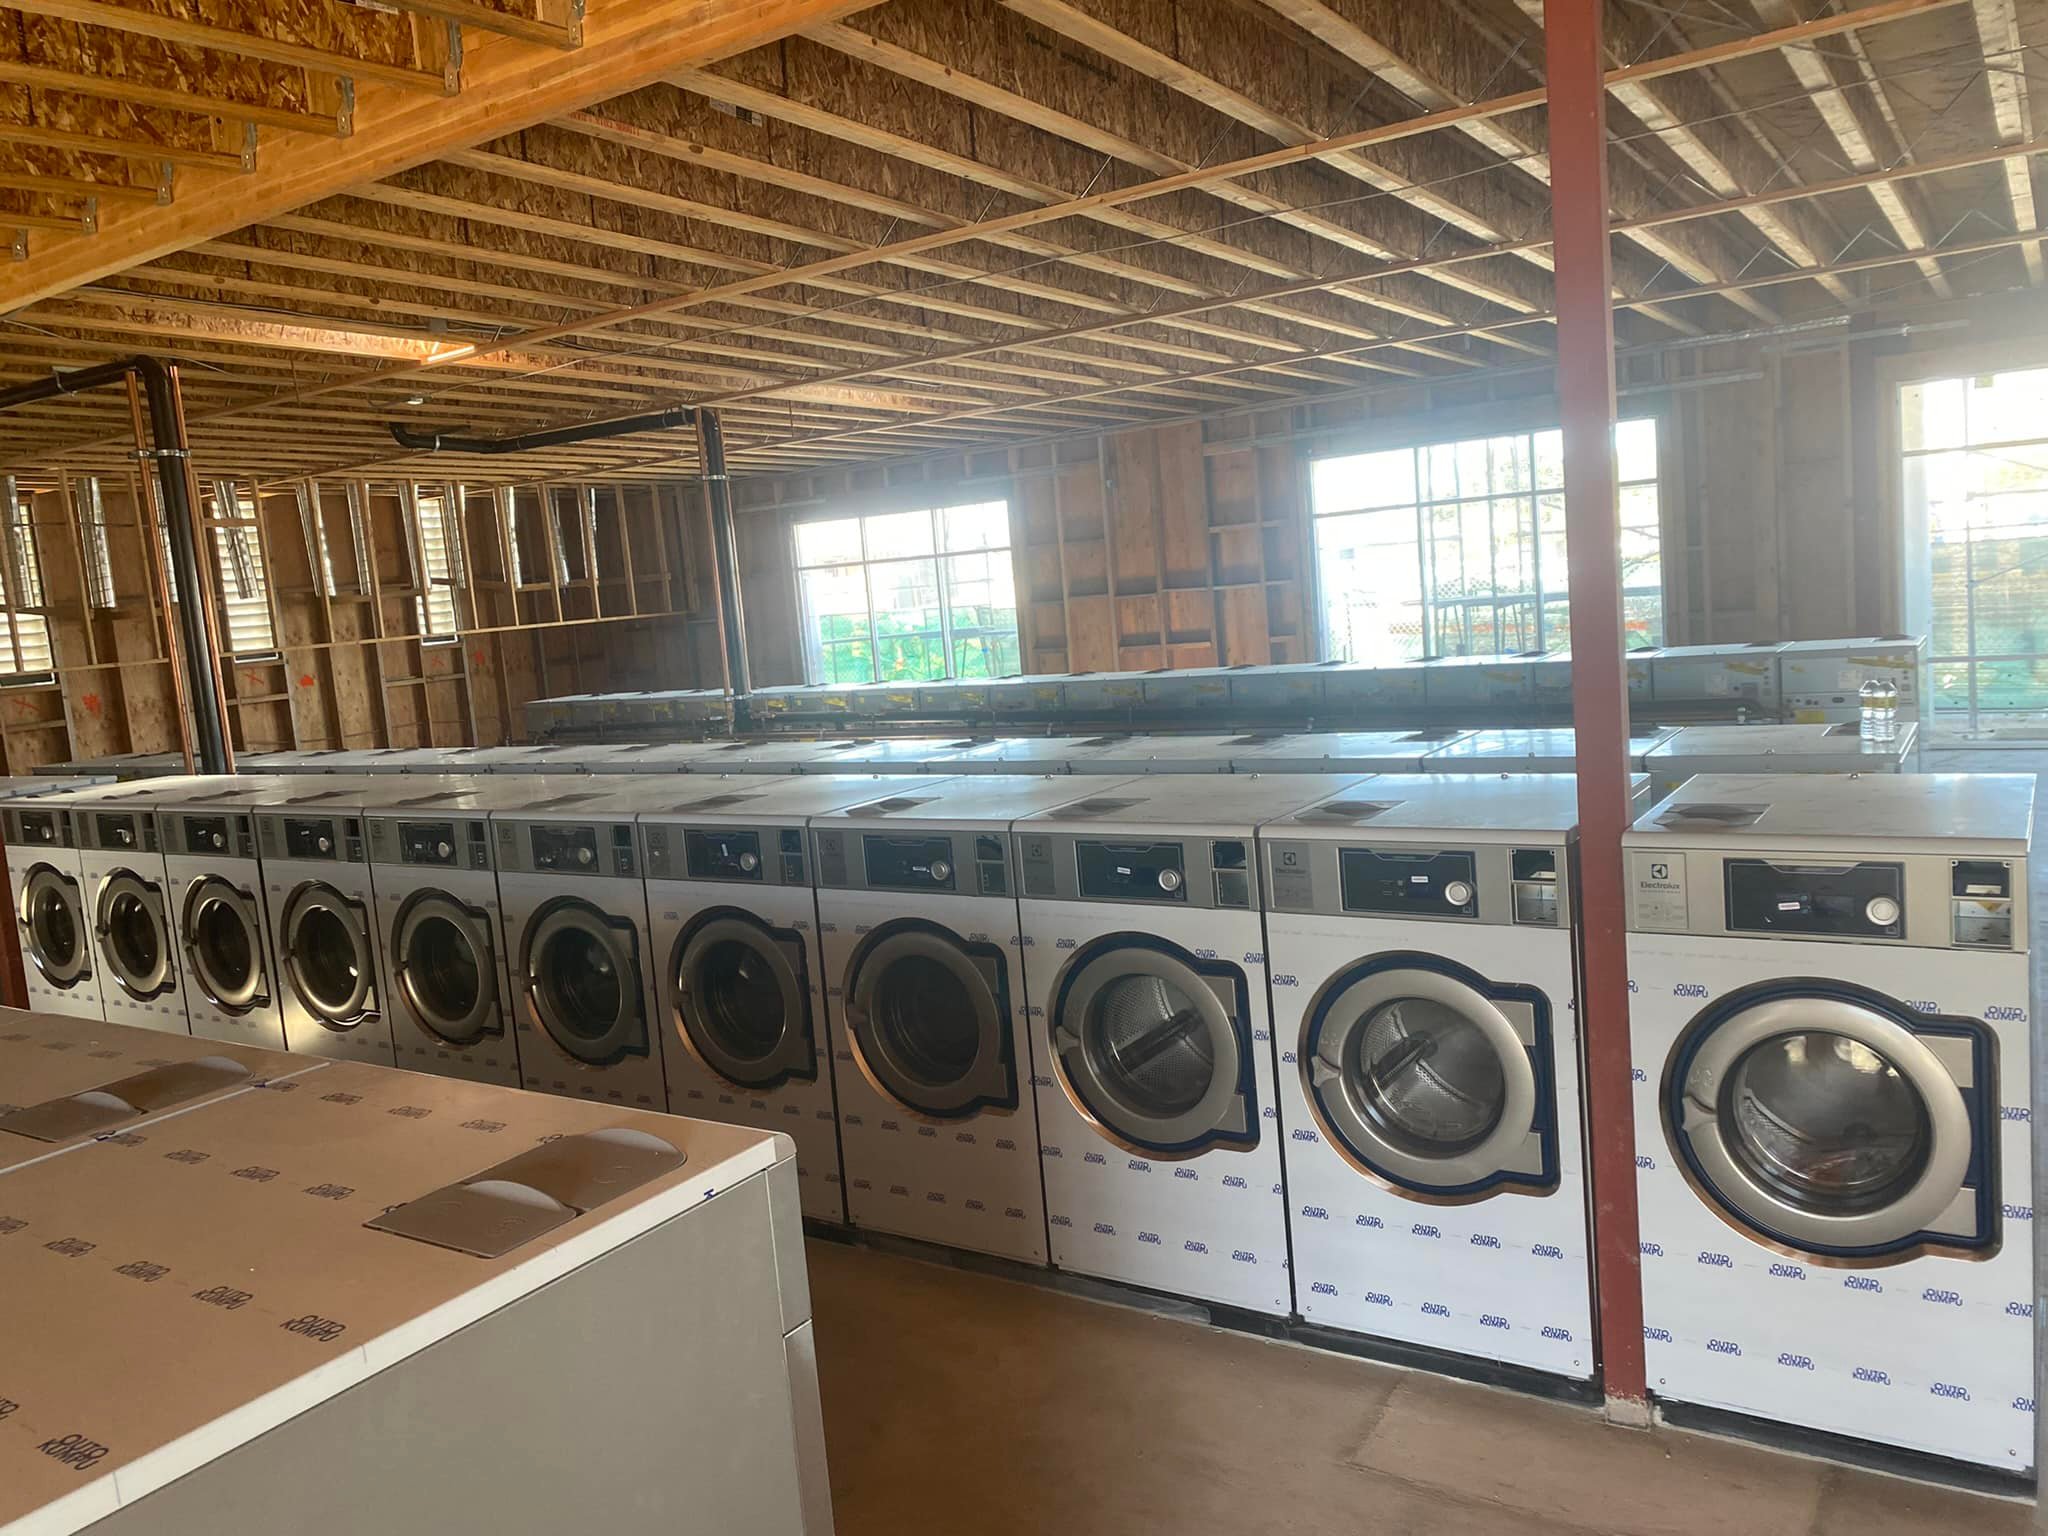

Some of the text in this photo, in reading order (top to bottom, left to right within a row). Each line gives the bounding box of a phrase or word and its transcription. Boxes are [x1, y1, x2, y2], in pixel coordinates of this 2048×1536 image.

[1701, 1251, 1728, 1261] OUTO
[1772, 1263, 1801, 1273] OUTO
[1847, 1275, 1879, 1285] OUTO
[1926, 1288, 1959, 1298] OUTO
[2005, 1306, 2032, 1317] KUM
[2009, 1302, 2032, 1310] OUT
[300, 1314, 346, 1333] OUTO
[1644, 1331, 1671, 1342] UMPU
[1709, 1339, 1738, 1349] OUTO
[1781, 1352, 1810, 1363] OUTO
[1856, 1367, 1887, 1378] OUTO
[1934, 1382, 1966, 1393] OUTO
[61, 1434, 109, 1457] OUTO
[37, 1438, 99, 1470] KUMPU
